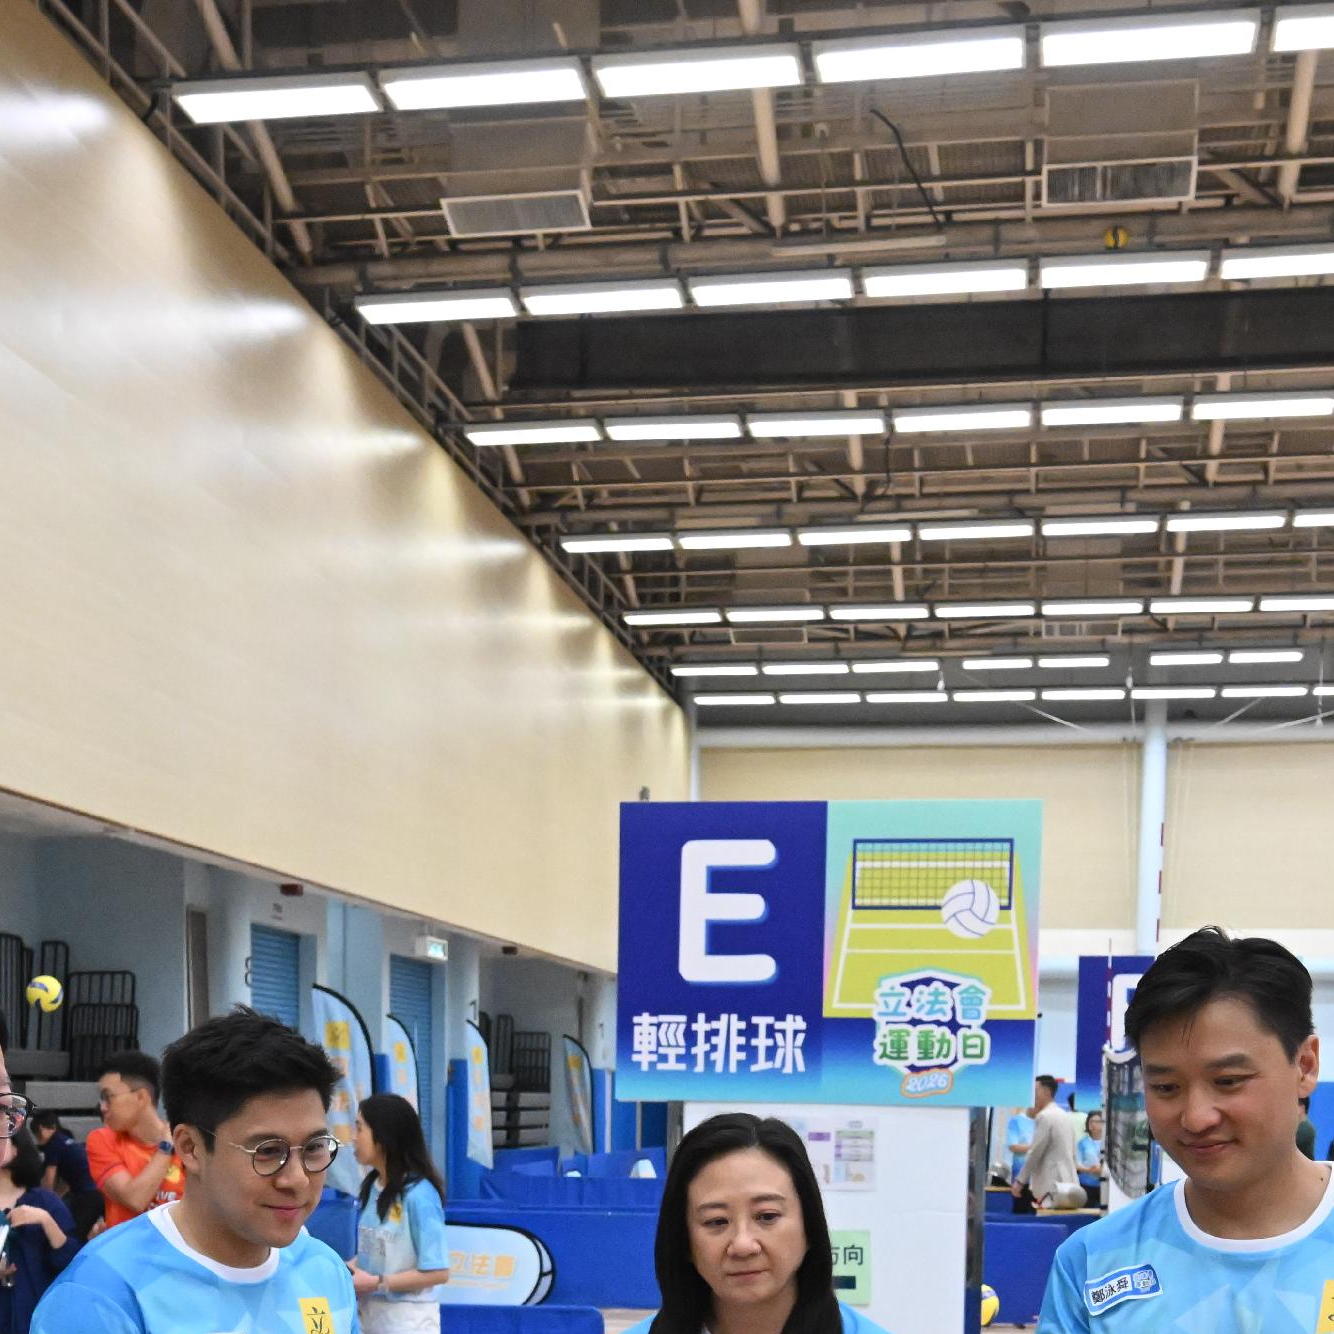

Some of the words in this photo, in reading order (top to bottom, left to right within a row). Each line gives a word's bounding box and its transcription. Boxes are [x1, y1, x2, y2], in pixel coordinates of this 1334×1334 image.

[678, 838, 777, 984] E
[877, 984, 987, 1021] 立法會
[631, 1012, 807, 1074] 輕排球
[878, 1028, 986, 1062] 運動日
[905, 1073, 950, 1093] 2026
